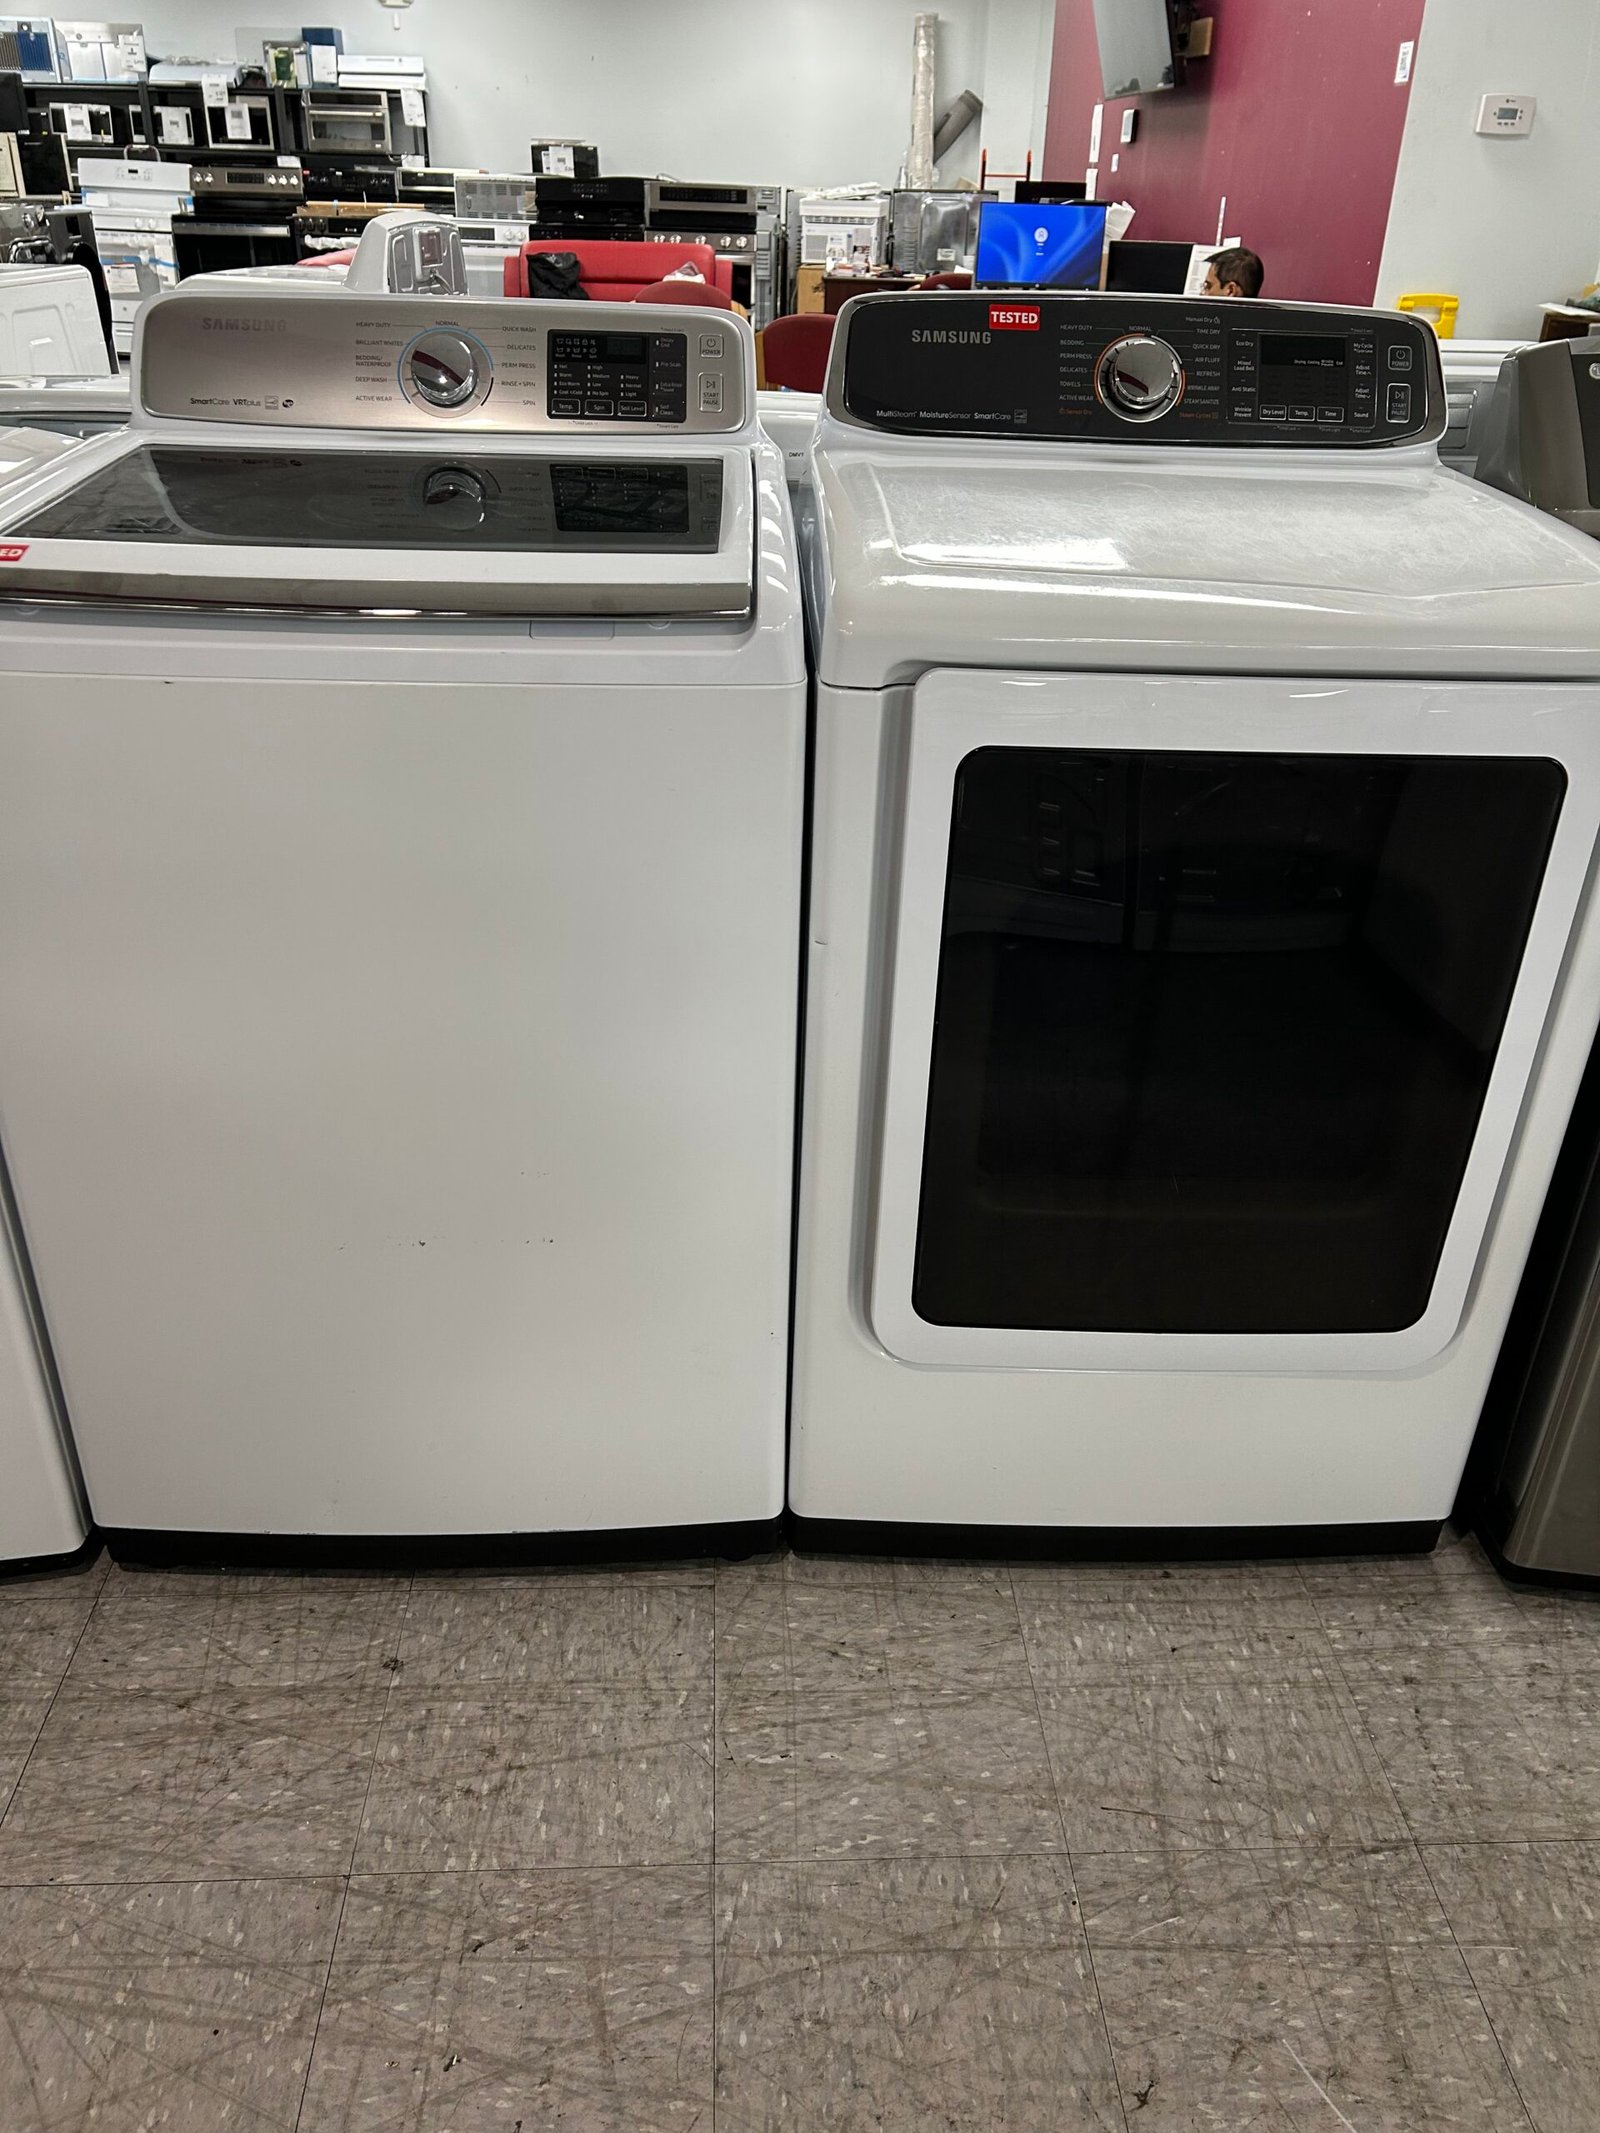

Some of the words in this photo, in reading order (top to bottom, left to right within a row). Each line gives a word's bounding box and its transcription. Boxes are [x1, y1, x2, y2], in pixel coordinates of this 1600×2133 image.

[991, 311, 1038, 324] TESTED
[202, 318, 287, 332] SAMSUNG
[912, 329, 992, 344] SAMSUNG
[233, 398, 261, 406] VRTplus
[920, 411, 971, 419] MoistureSensor
[974, 412, 1011, 420] SmartCare
